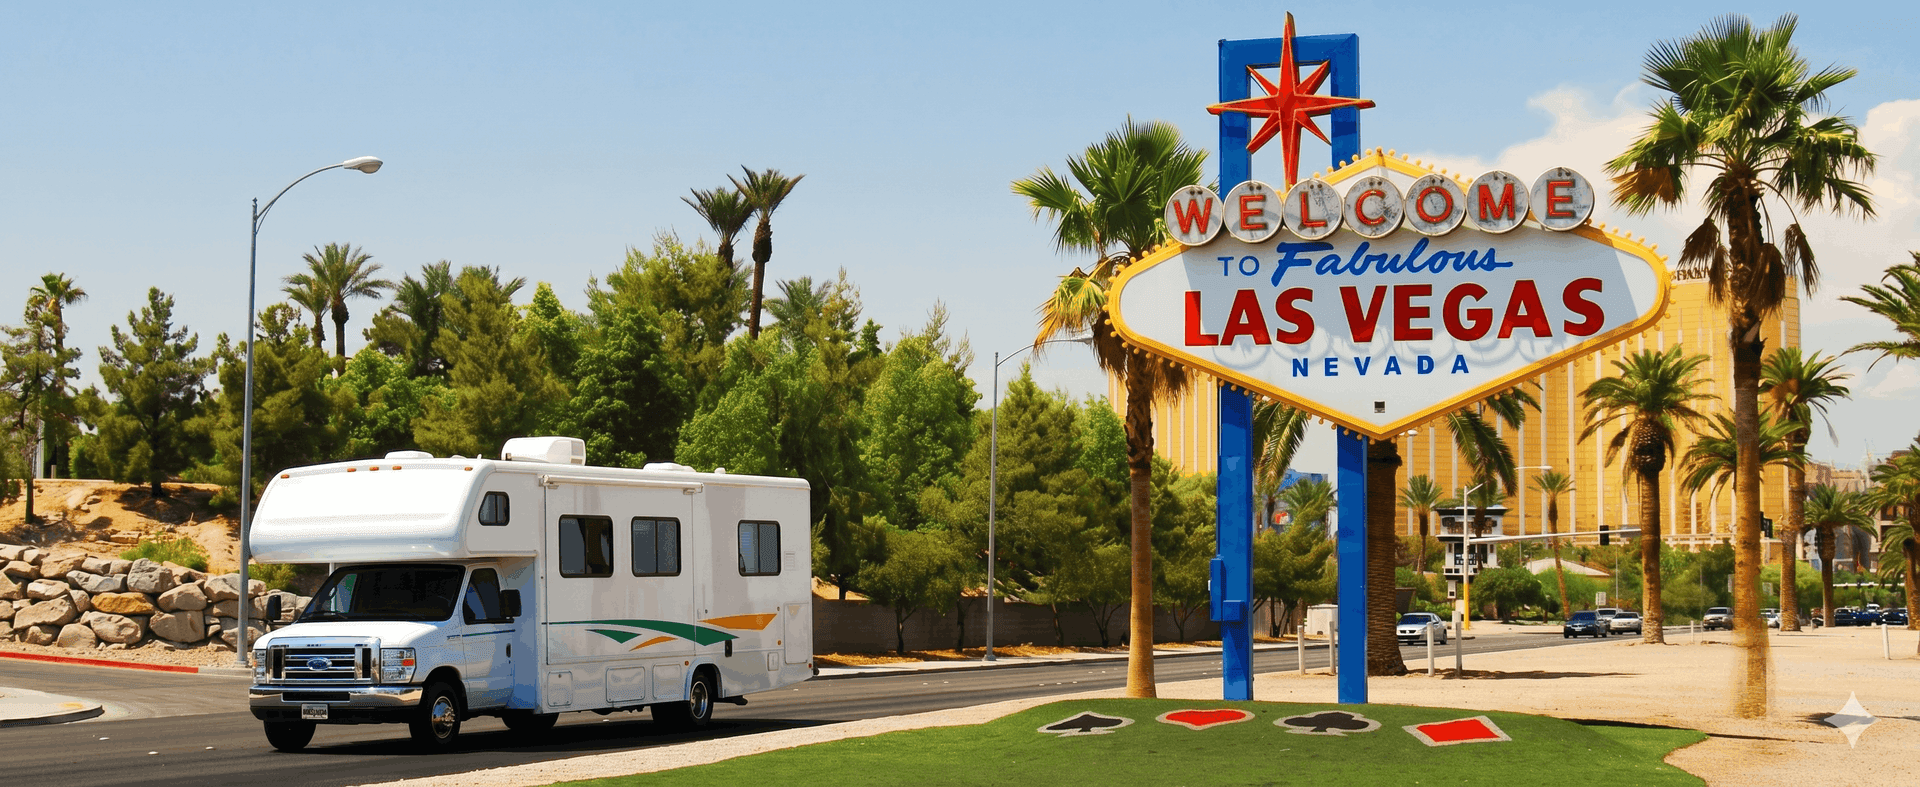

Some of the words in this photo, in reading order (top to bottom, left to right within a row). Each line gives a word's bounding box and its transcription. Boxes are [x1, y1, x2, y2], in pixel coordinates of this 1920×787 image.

[1172, 179, 1577, 235] WELCOME
[1217, 255, 1260, 277] TO
[1270, 237, 1514, 288] Fabulous
[1184, 288, 1315, 347] LAS
[1340, 278, 1605, 342] VEGAS
[1292, 354, 1470, 377] NEVADA
